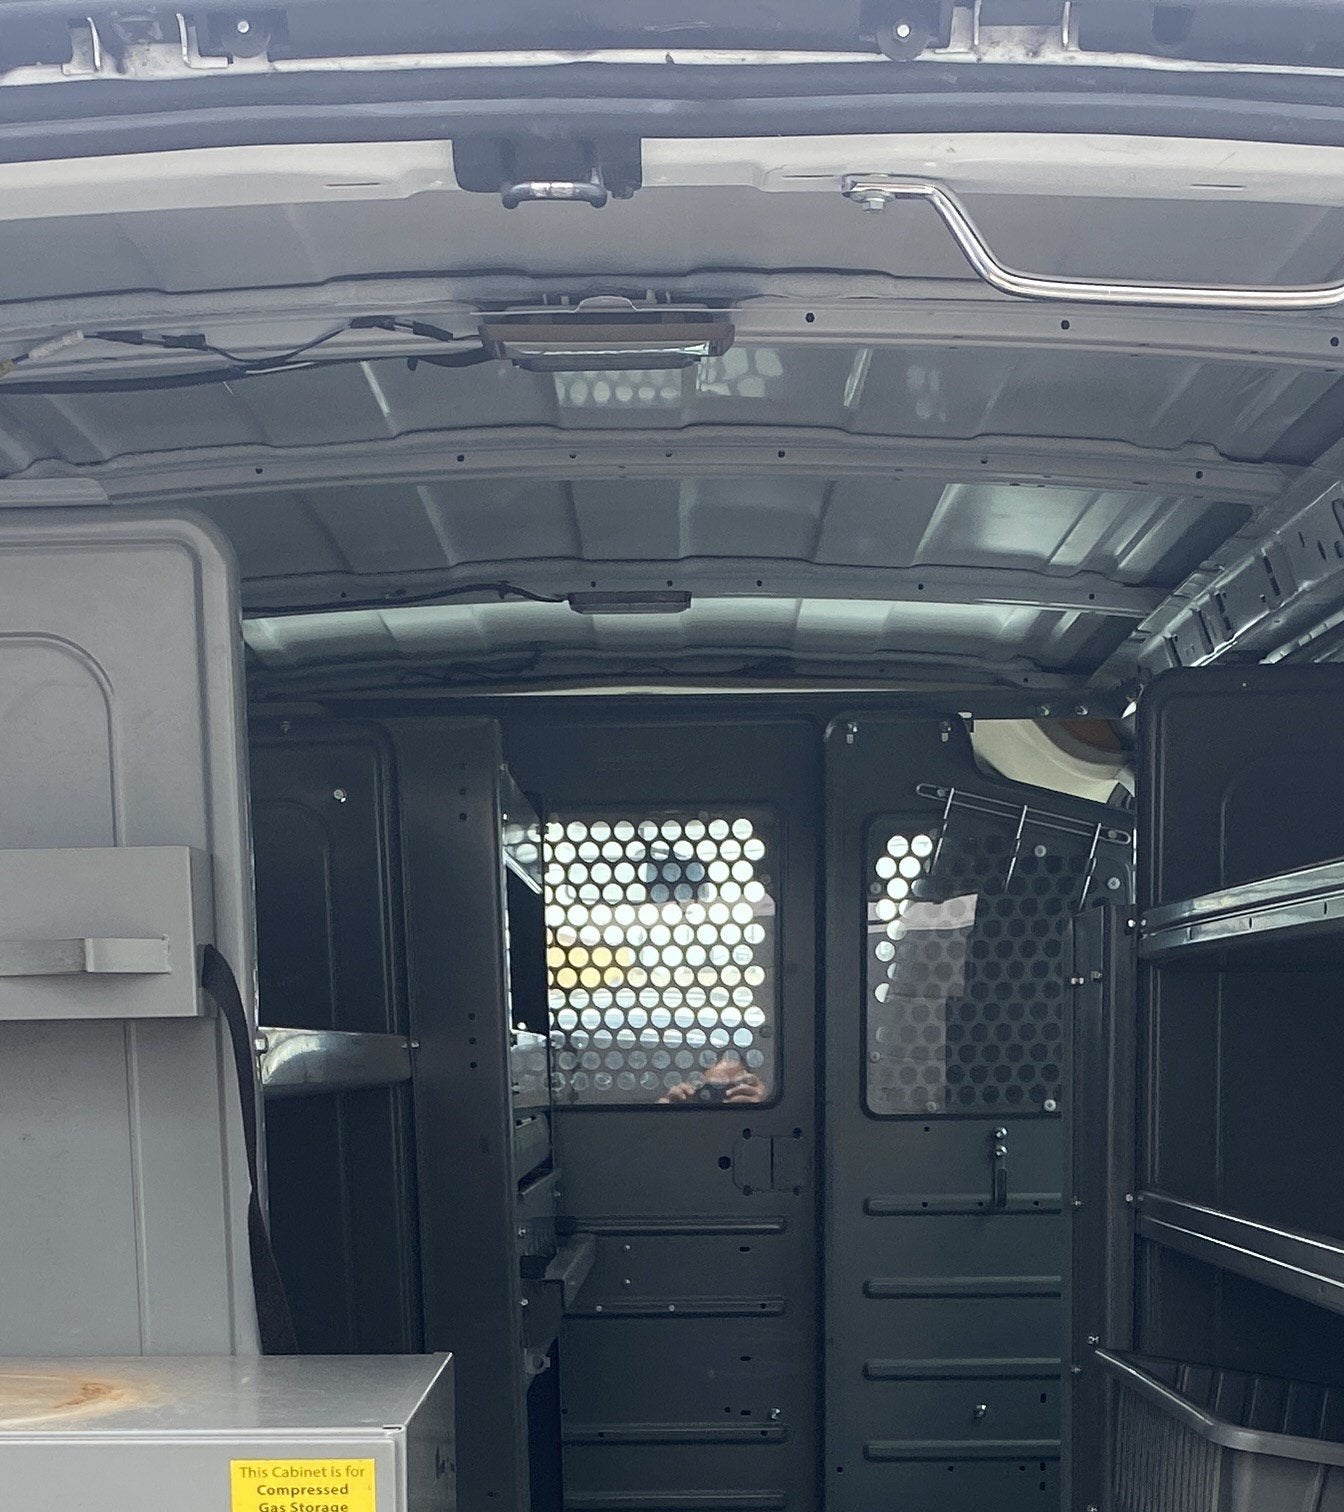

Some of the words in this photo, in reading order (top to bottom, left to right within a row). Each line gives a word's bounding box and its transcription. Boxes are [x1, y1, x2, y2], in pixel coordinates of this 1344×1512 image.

[240, 1466, 268, 1478] This
[272, 1465, 327, 1478] Cabinet
[331, 1466, 341, 1478] is
[345, 1465, 365, 1477] for
[257, 1483, 349, 1498] Compressed
[259, 1502, 286, 1512] Gas
